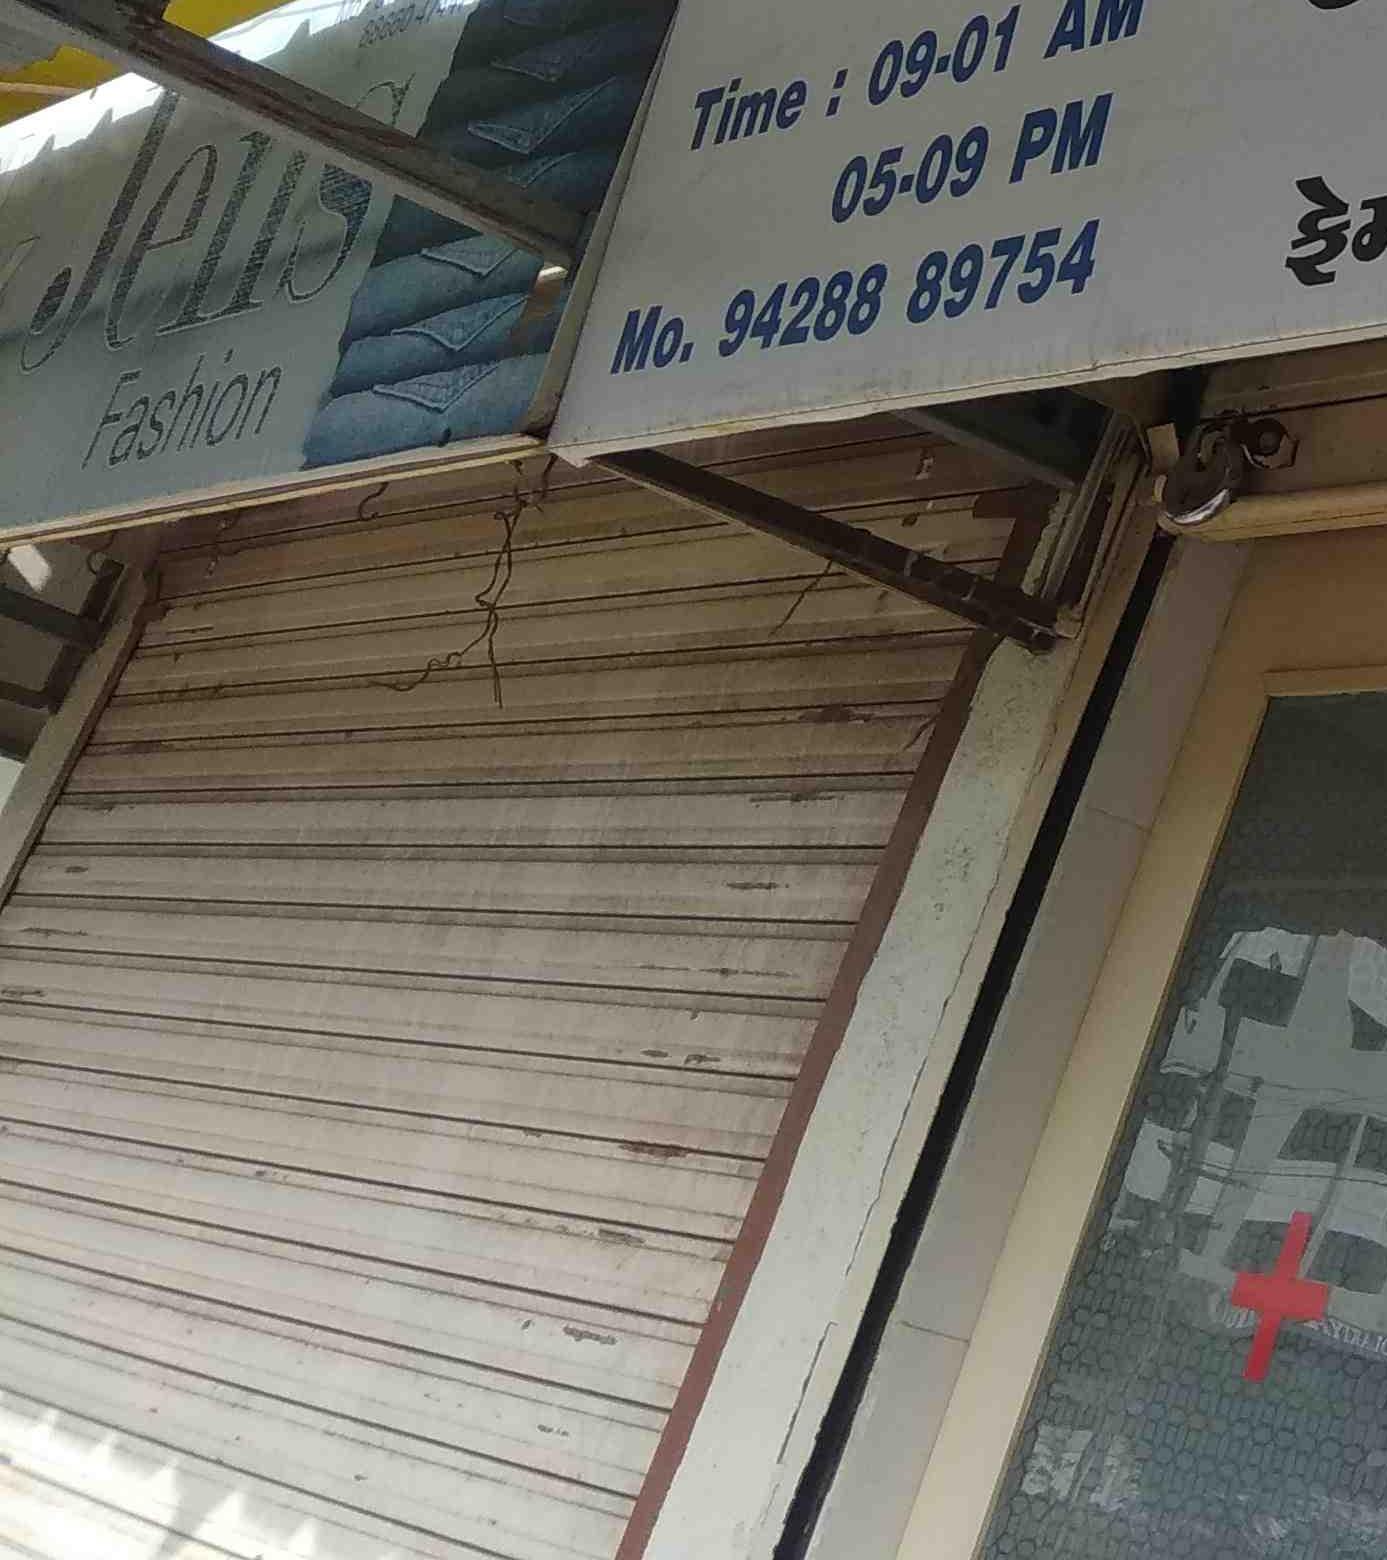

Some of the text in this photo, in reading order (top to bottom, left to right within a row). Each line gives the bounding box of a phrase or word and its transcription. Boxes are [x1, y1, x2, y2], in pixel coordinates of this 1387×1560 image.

[690, 70, 808, 151] Time
[866, 4, 1022, 108] 09-01
[830, 91, 1114, 223] 05-09 PM
[610, 218, 1100, 376] Mo. 94288 89754
[82, 348, 283, 471] Fashion
